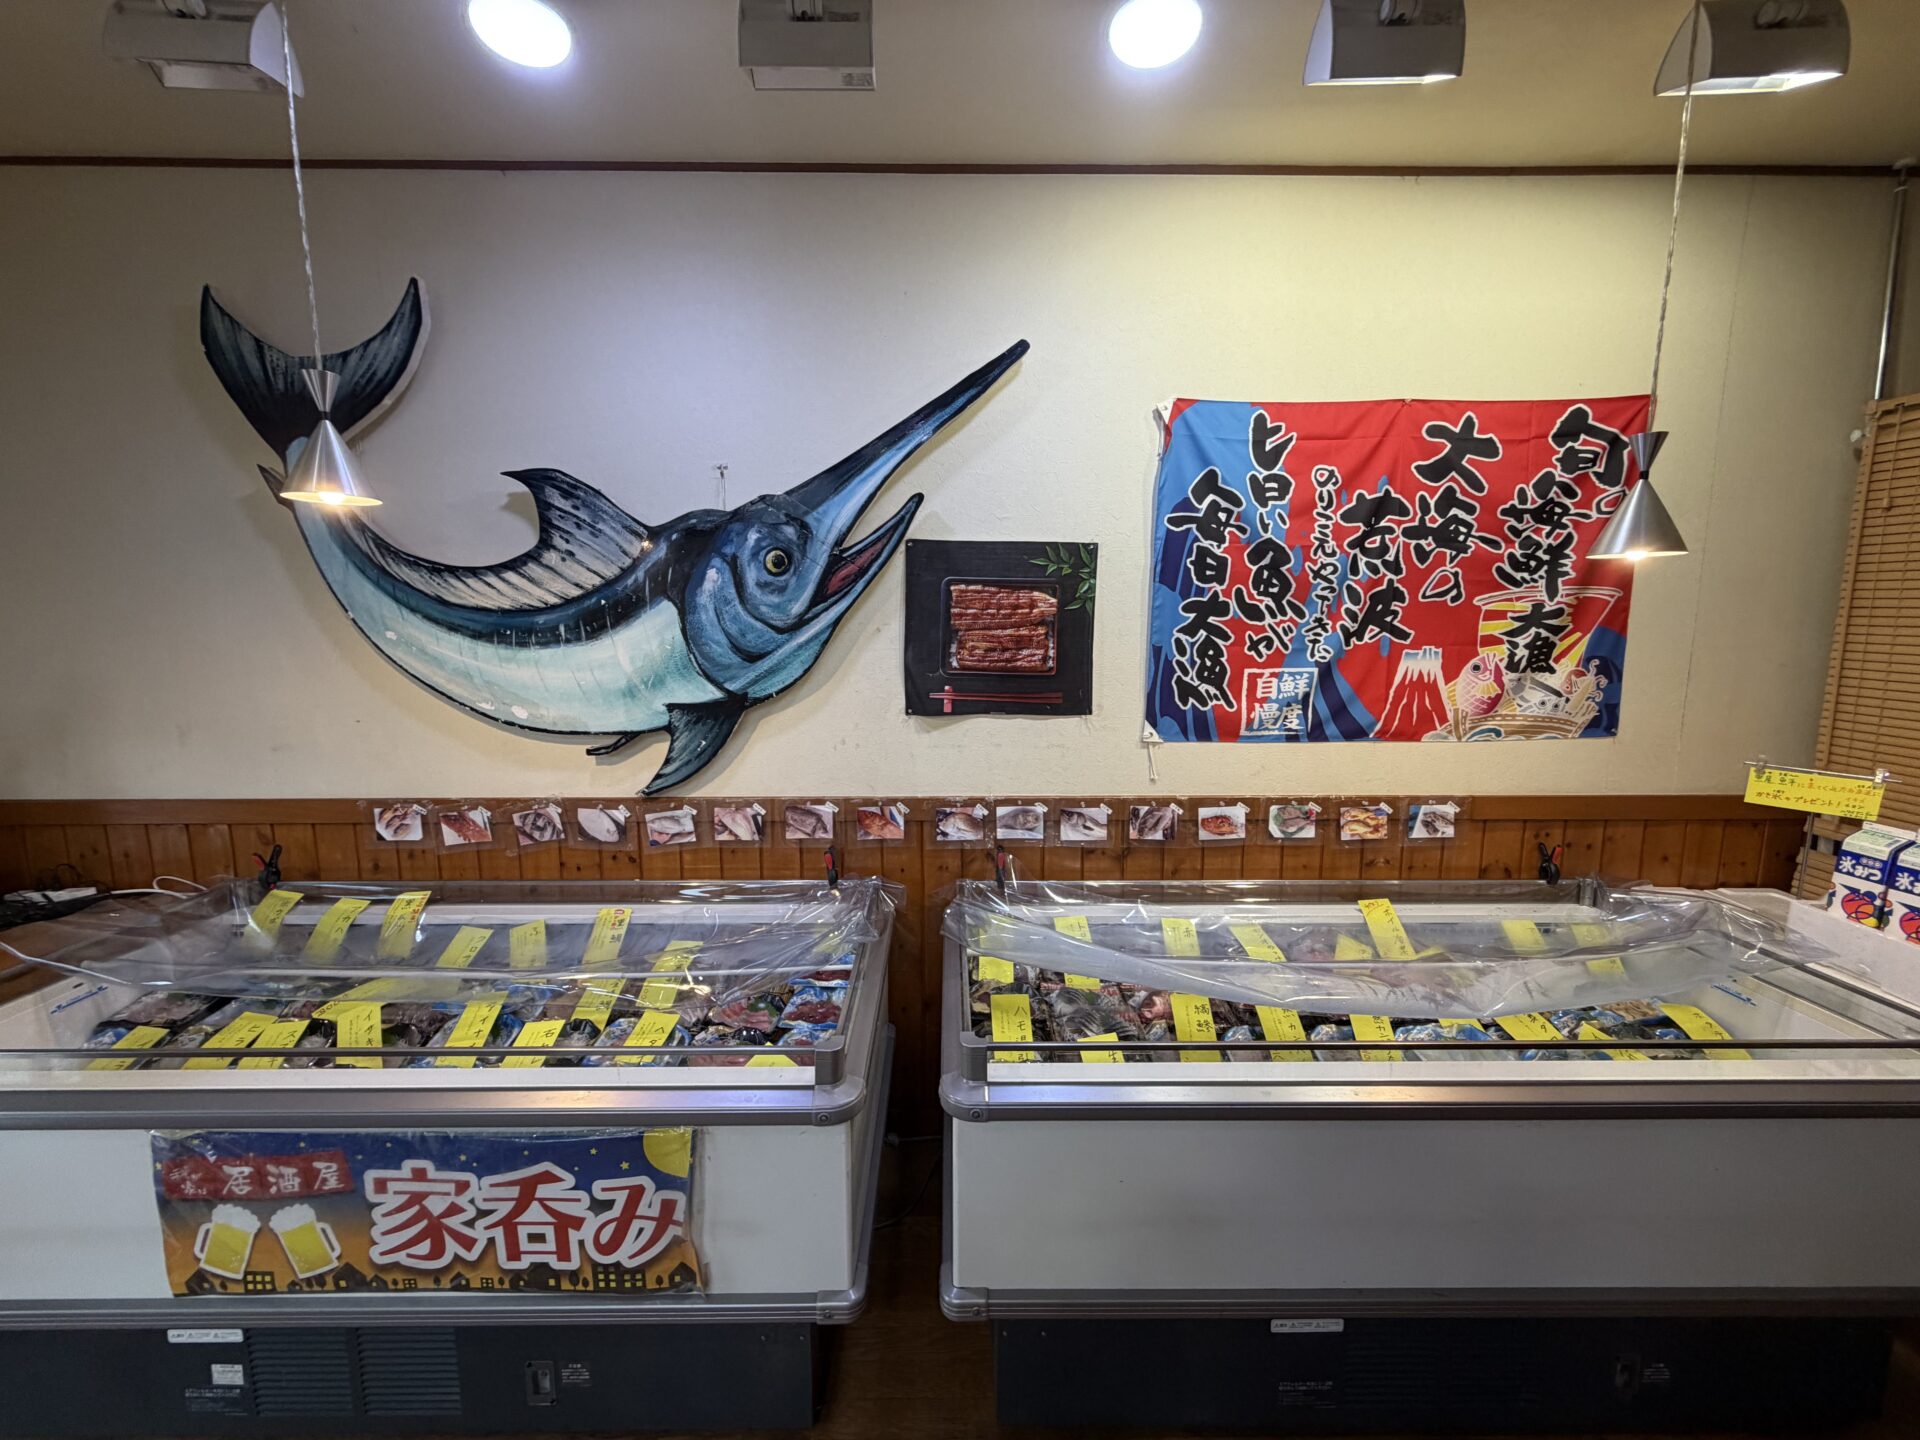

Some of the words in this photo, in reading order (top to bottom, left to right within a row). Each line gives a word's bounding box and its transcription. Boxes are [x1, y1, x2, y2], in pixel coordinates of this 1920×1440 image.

[1165, 466, 1250, 711] 毎日大漁
[1839, 856, 1882, 881] 氷みつ
[221, 1160, 345, 1196] 居酒屋
[370, 1159, 687, 1266] 家呑み
